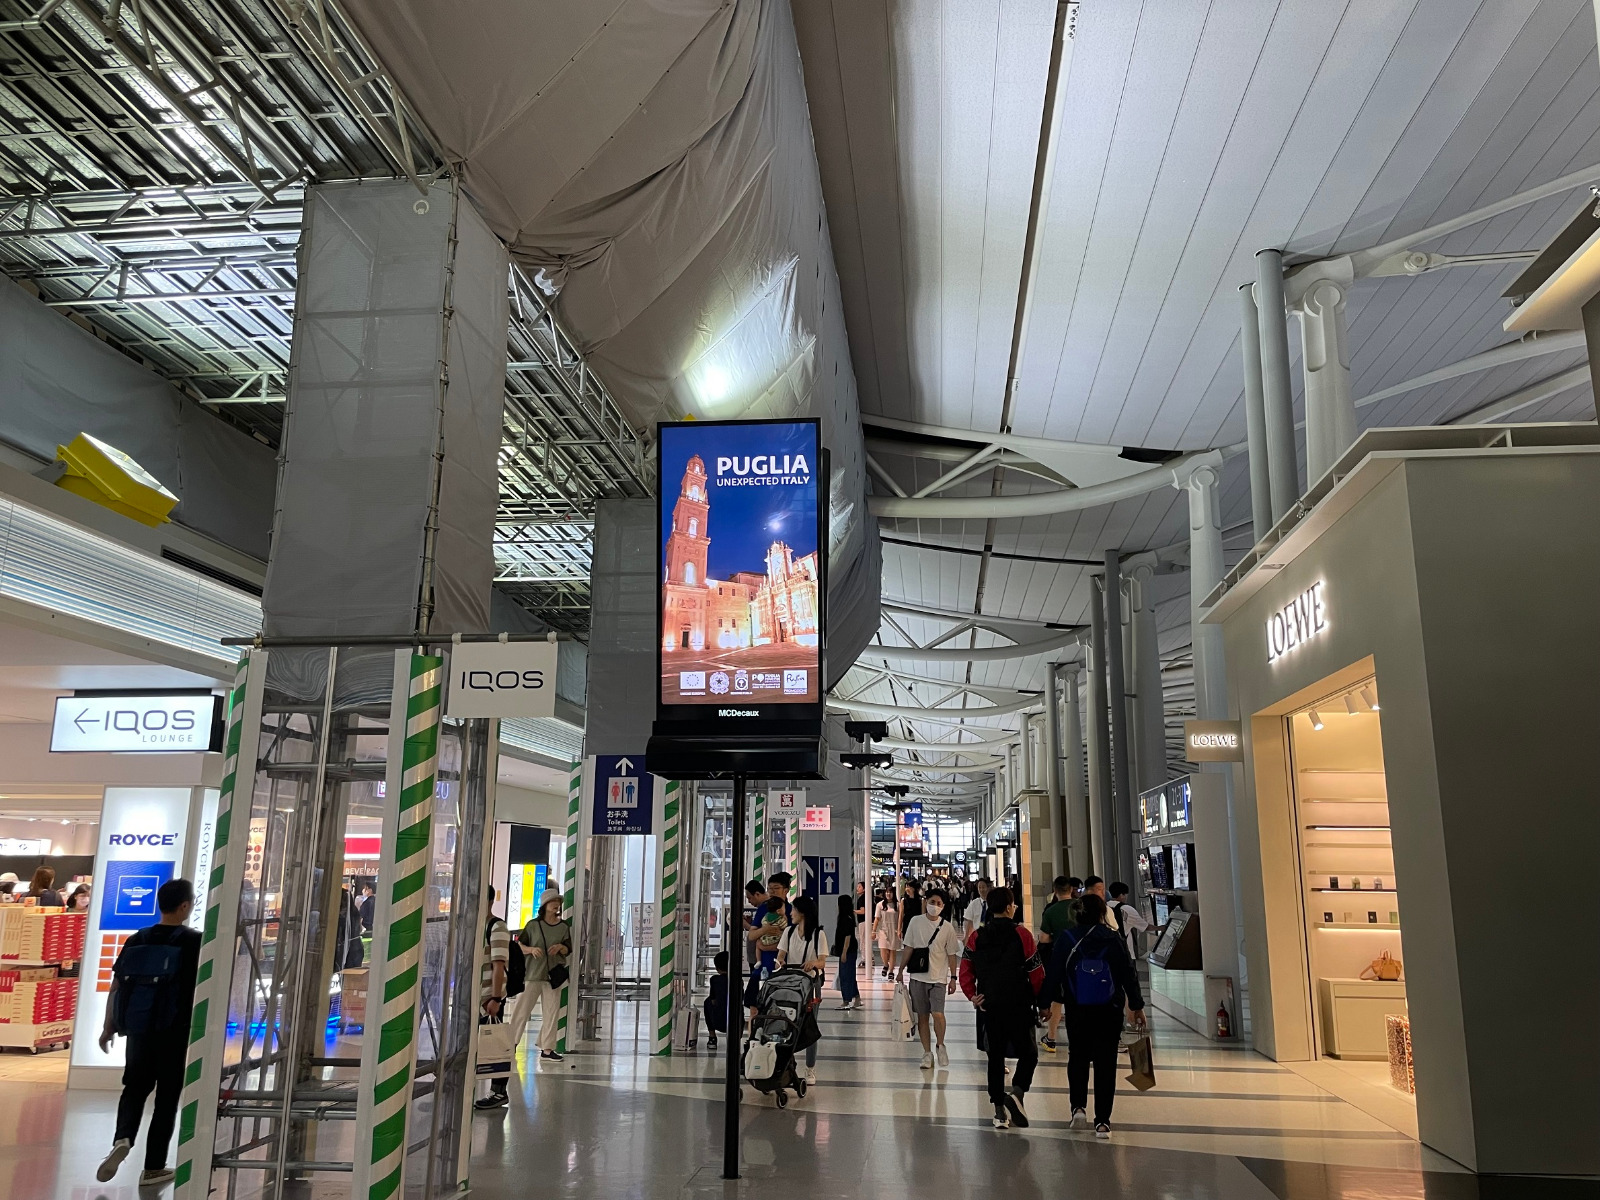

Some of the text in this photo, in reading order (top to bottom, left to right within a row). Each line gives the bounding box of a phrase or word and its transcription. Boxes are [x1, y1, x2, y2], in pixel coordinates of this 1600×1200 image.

[717, 455, 809, 476] PUGLIA
[716, 476, 810, 486] UNEXPECTED ITALY
[1265, 581, 1325, 663] LOEWE
[461, 670, 544, 692] IQOS
[718, 709, 760, 717] MCDecaux
[104, 709, 195, 735] IQOS
[142, 734, 193, 743] LOUNGE
[1192, 734, 1238, 747] LOEWE
[606, 810, 629, 818] お手洗
[109, 832, 179, 846] ROYCE'
